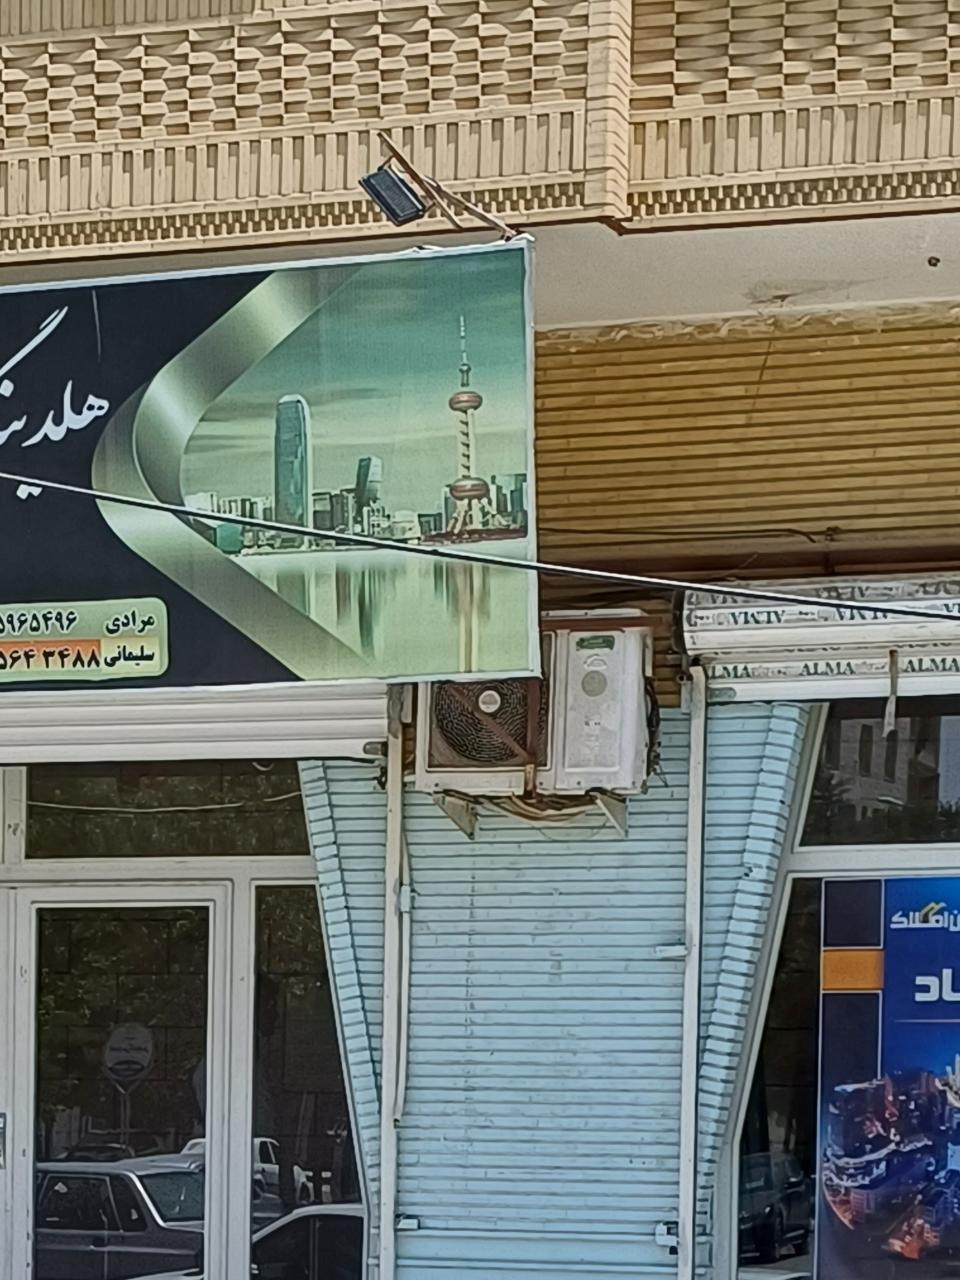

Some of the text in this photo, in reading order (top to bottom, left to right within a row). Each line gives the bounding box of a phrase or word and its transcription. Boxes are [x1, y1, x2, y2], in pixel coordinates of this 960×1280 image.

[105, 610, 155, 634] مرادی
[104, 644, 155, 667] سلیمانی
[709, 657, 960, 679] LMA ALMA ALMA
